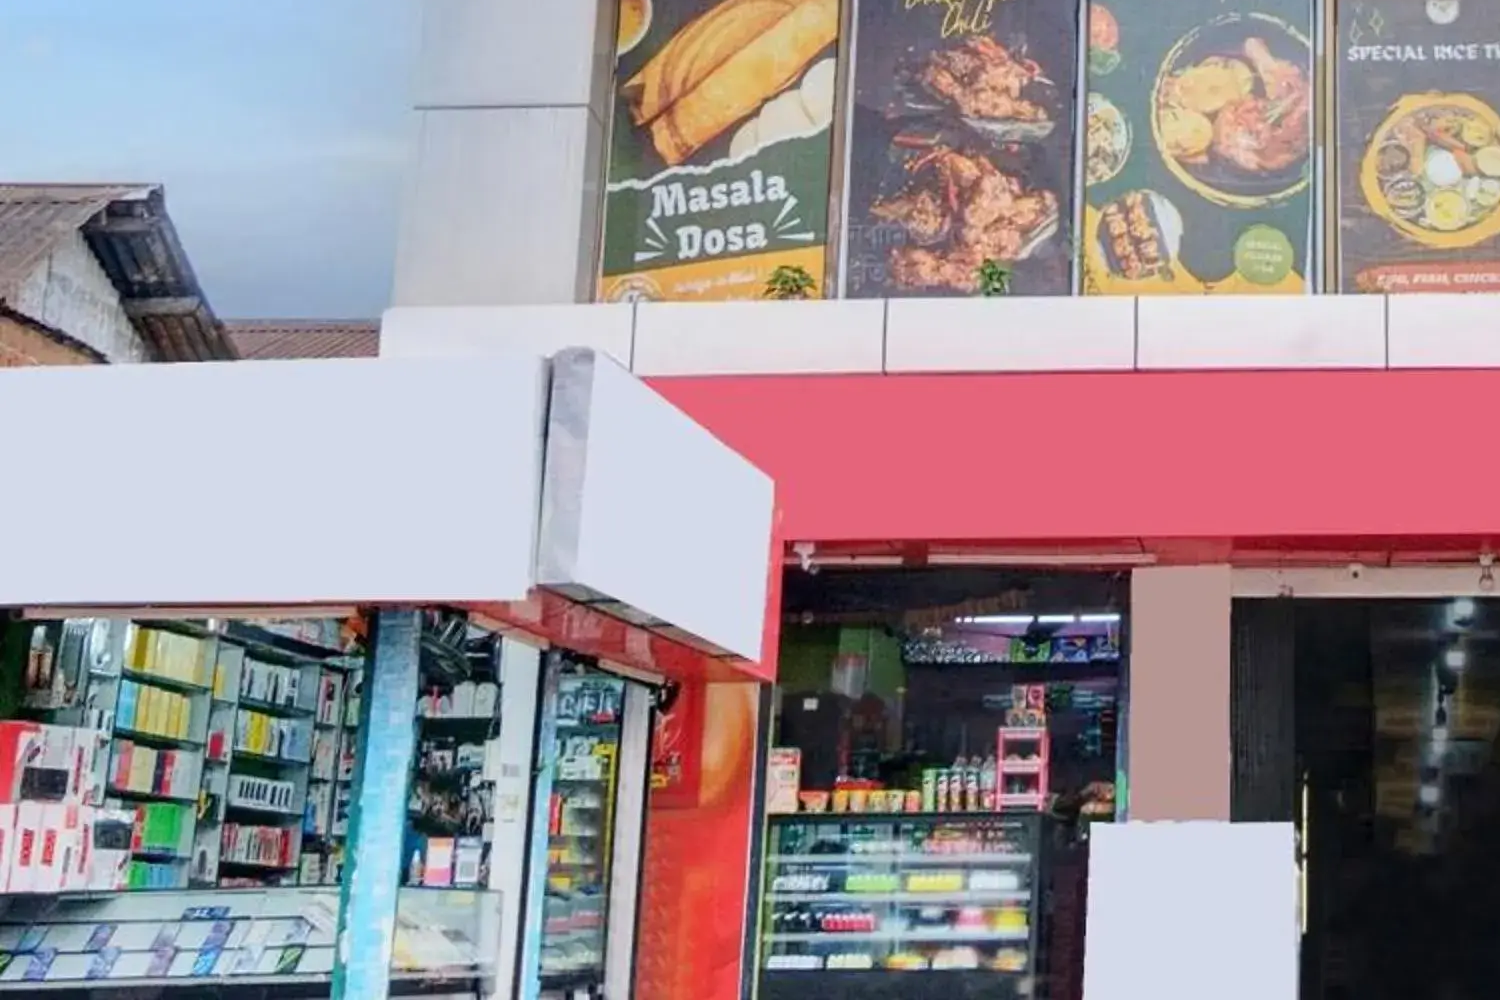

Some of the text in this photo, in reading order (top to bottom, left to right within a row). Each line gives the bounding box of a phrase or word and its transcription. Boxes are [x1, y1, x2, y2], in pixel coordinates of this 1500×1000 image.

[1347, 45, 1428, 62] SPECIAL
[1433, 44, 1479, 61] RICE
[651, 170, 789, 218] Masala
[675, 222, 768, 260] Dosa
